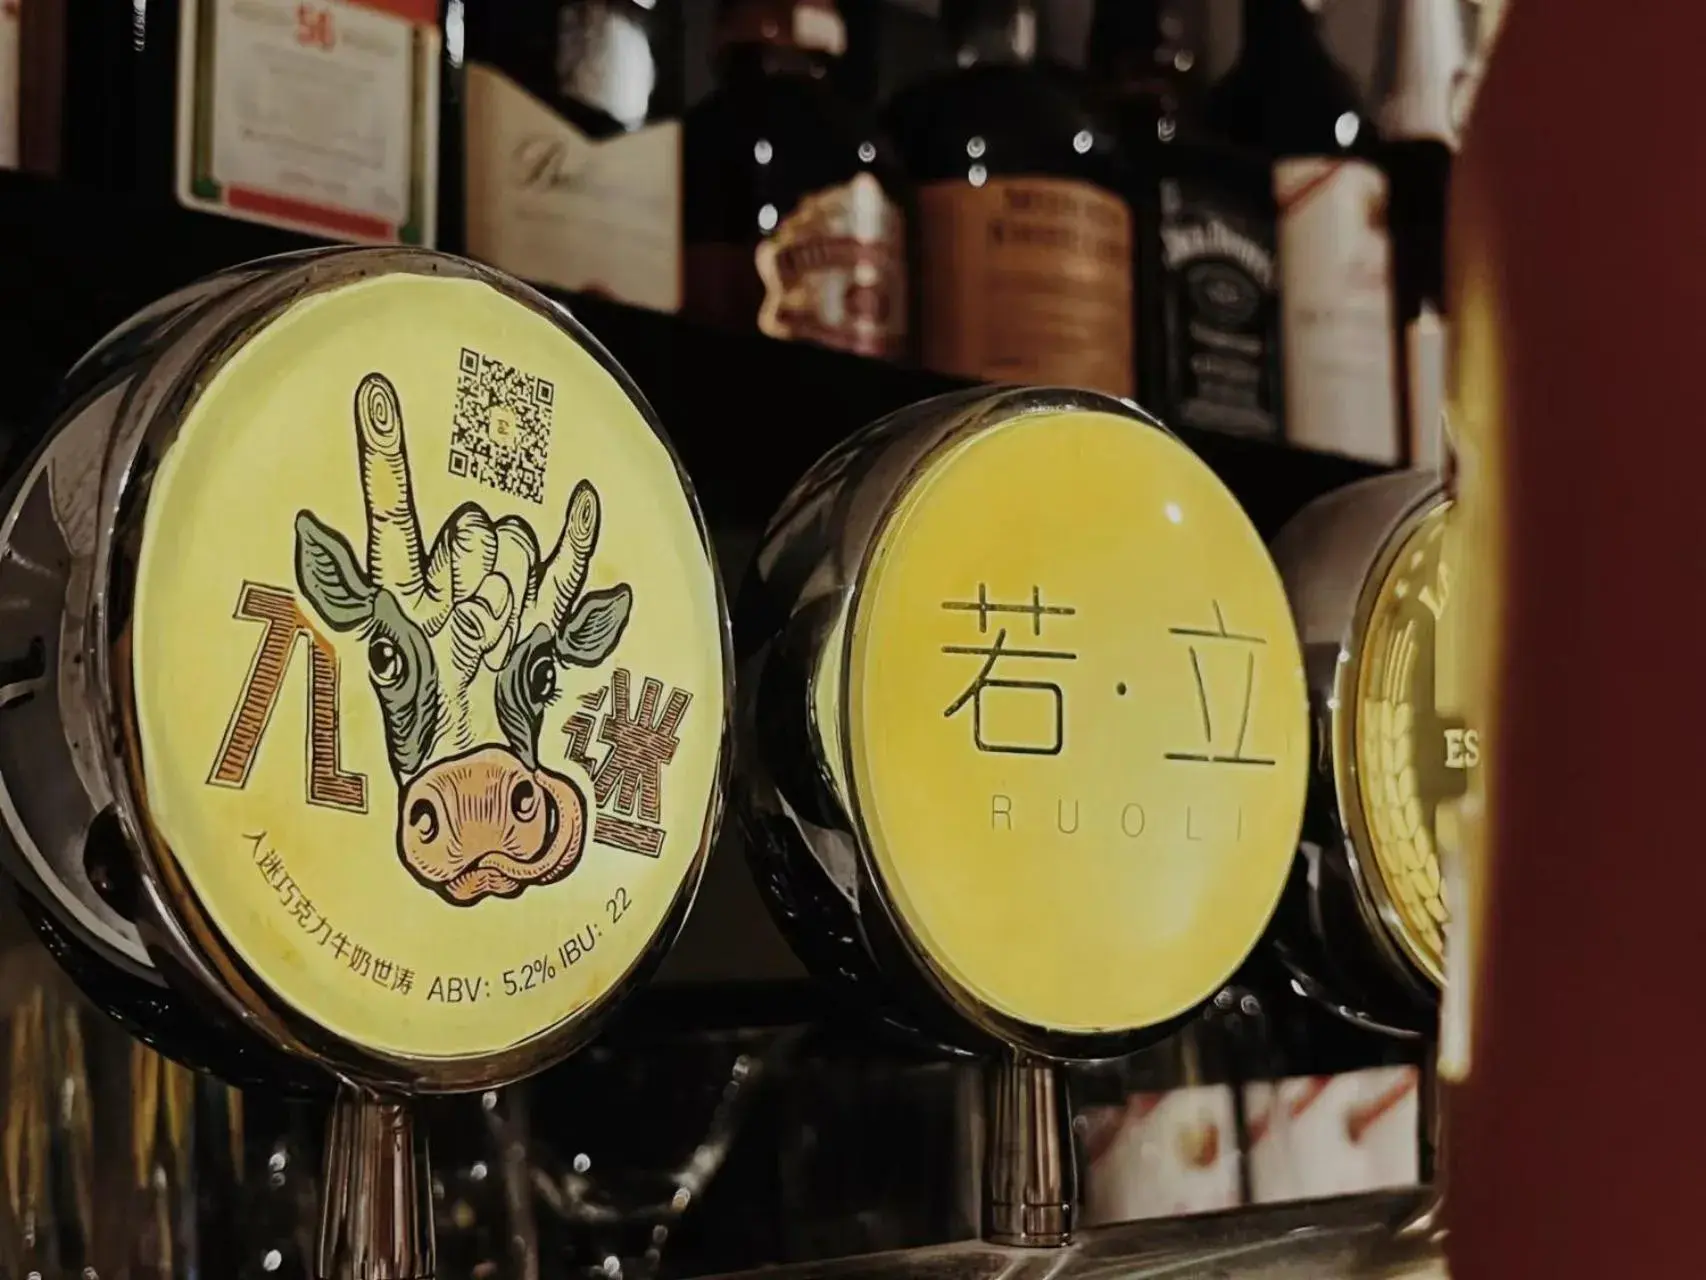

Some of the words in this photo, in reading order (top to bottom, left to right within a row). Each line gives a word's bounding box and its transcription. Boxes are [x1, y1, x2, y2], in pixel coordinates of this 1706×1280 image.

[242, 830, 416, 996] 人迷巧克力牛奶世涛
[426, 975, 491, 1003] ABV:
[502, 954, 556, 996] 5.2%
[557, 923, 603, 969] IBU:
[605, 886, 633, 924] 22
